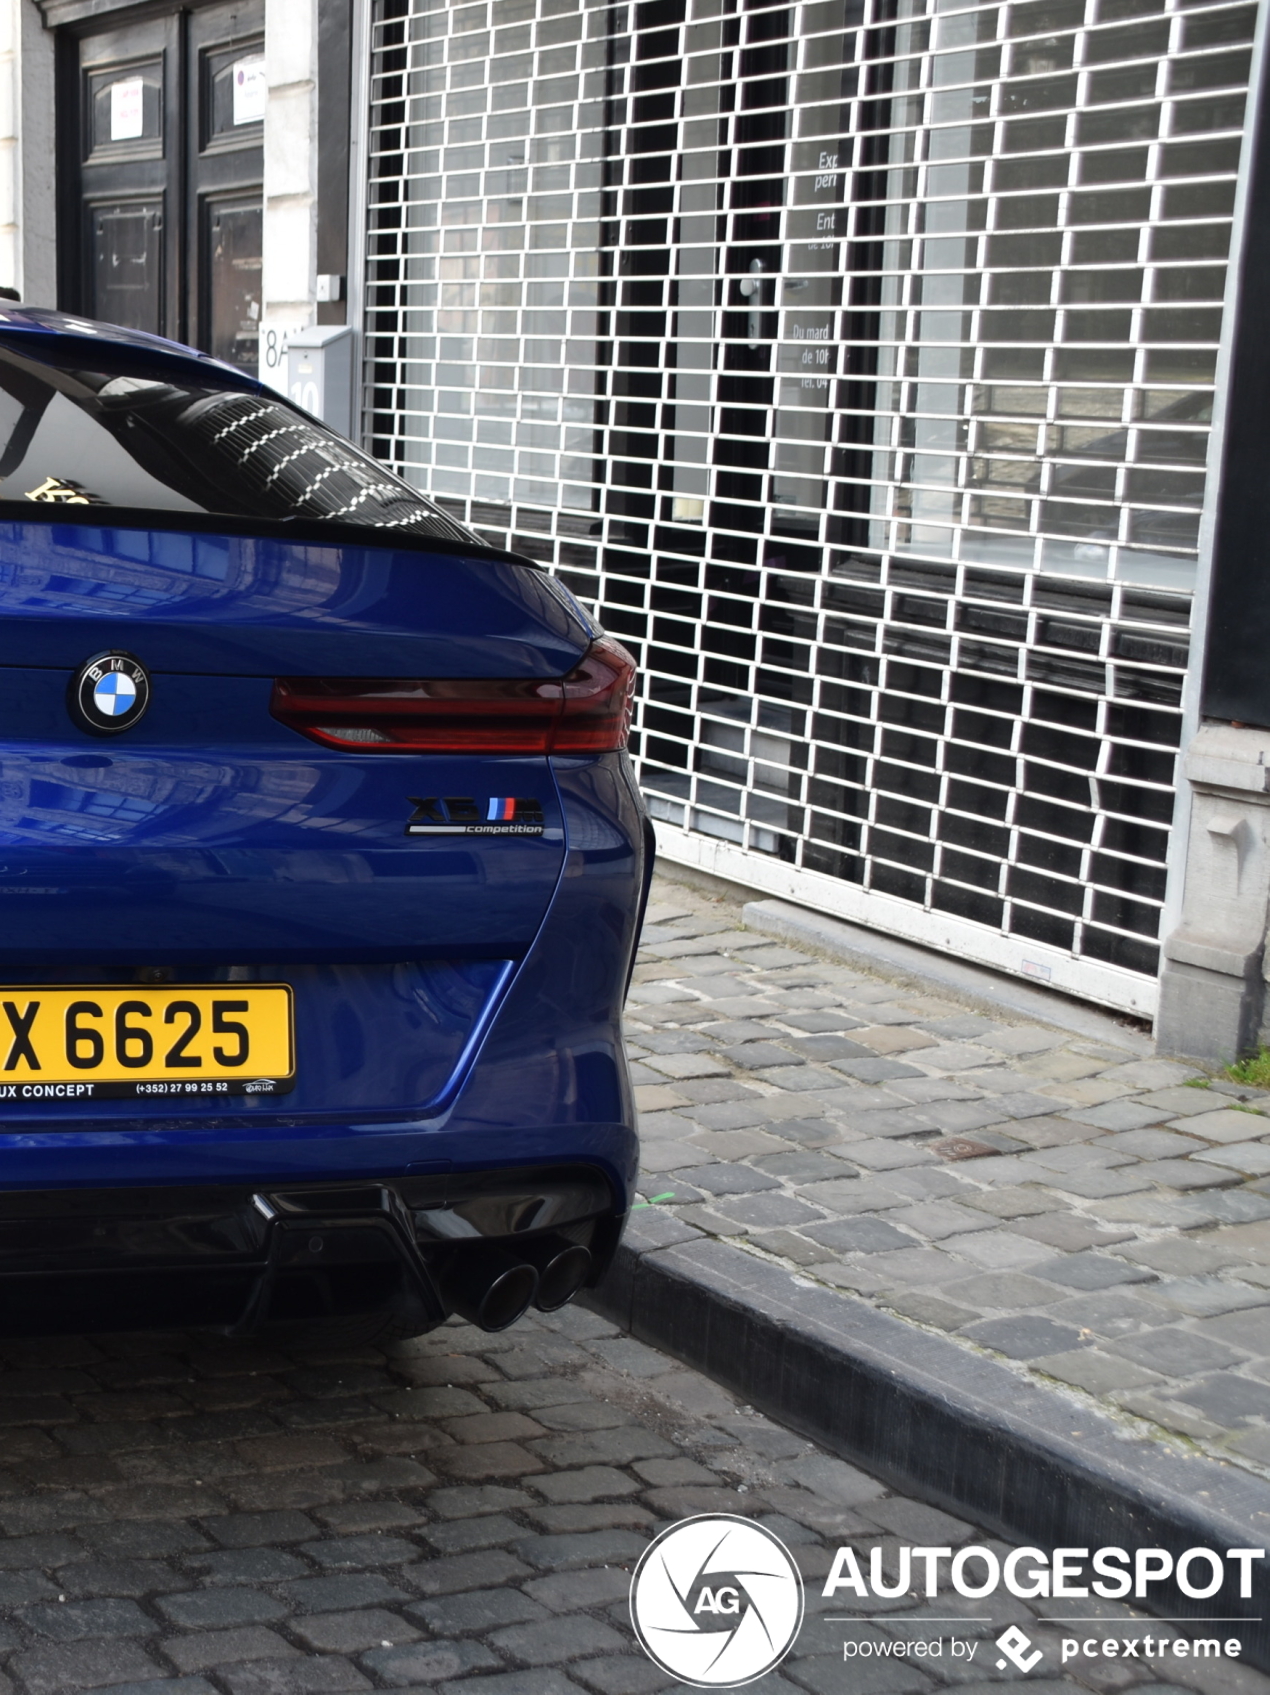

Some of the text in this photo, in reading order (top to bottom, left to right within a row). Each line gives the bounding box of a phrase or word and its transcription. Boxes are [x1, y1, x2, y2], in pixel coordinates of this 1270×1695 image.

[802, 348, 813, 364] de
[89, 659, 144, 684] BMW
[408, 797, 480, 822] X6
[466, 825, 543, 835] competition
[64, 1000, 250, 1070] 6625
[21, 1084, 95, 1098] CONCEPT
[135, 1082, 228, 1094] (+352) 27 99 25 52
